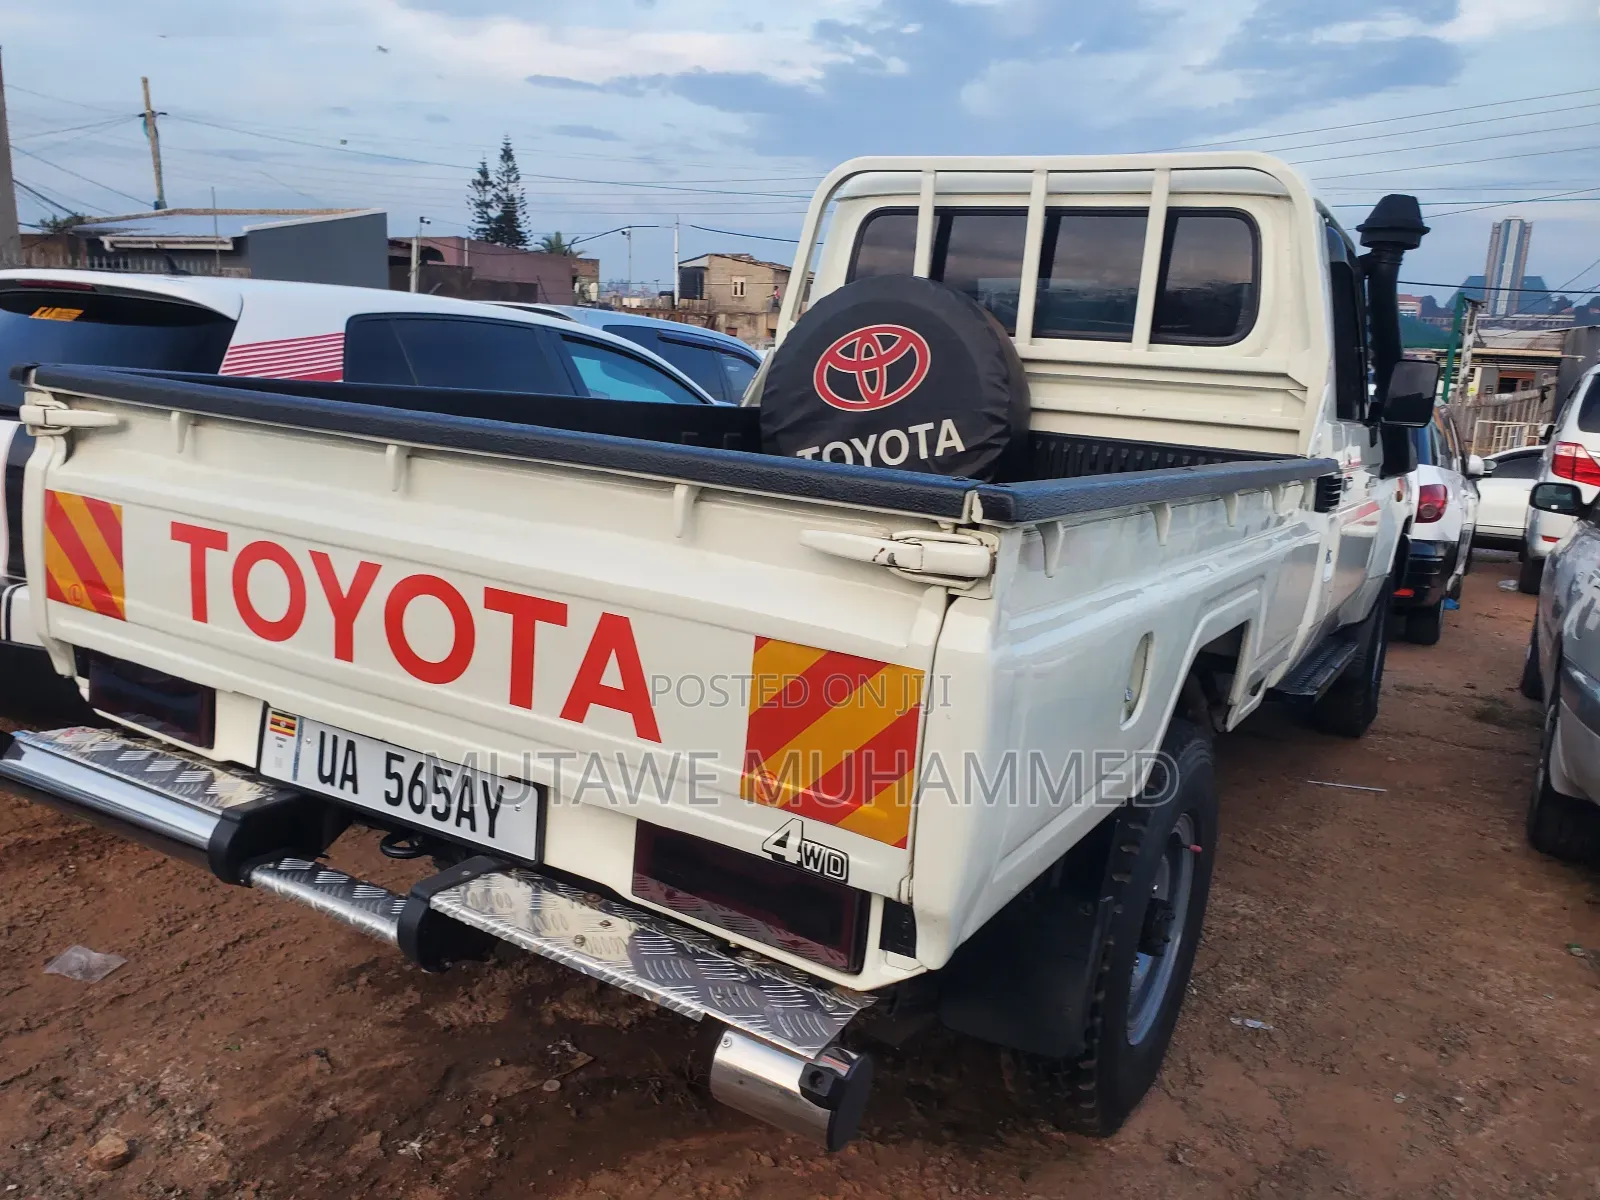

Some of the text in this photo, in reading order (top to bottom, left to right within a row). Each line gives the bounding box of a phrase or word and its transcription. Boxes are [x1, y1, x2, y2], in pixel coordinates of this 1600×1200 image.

[171, 520, 662, 744] TOYOTA
[318, 730, 504, 839] UA 565AY
[761, 818, 849, 883] 4WD
